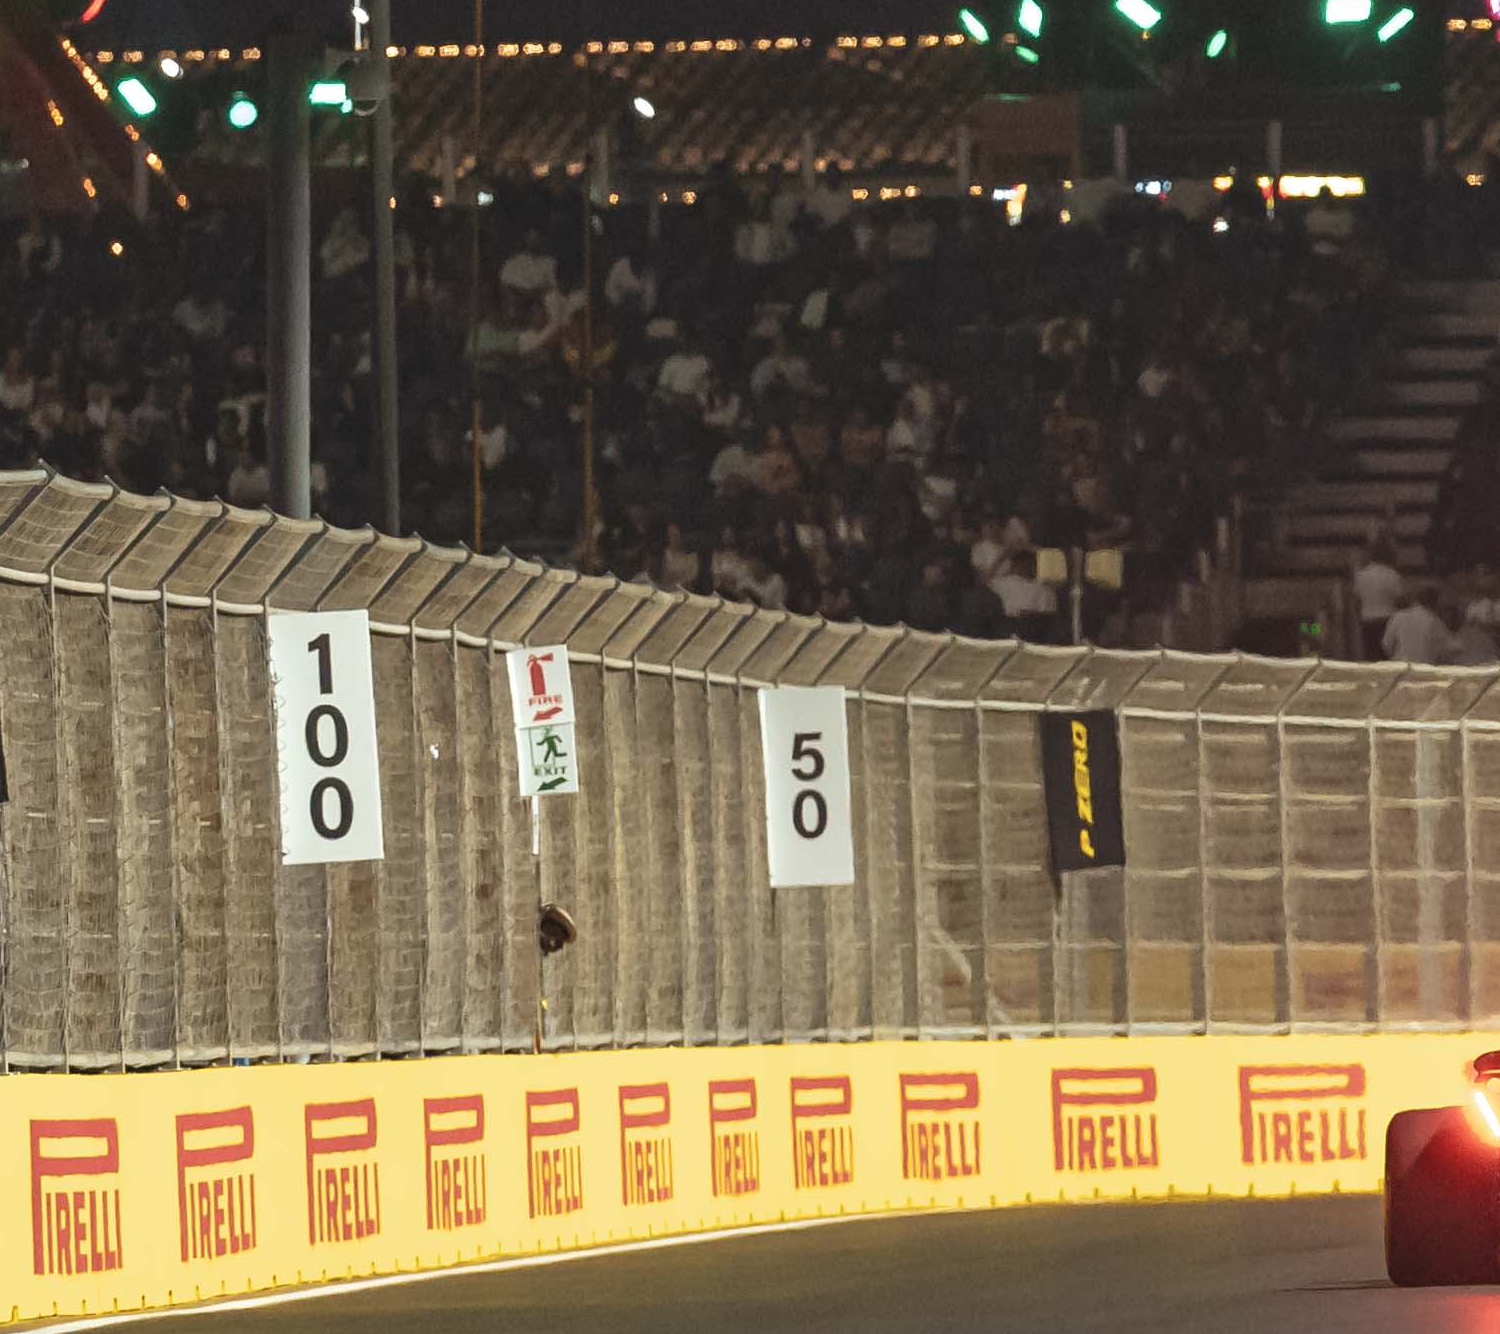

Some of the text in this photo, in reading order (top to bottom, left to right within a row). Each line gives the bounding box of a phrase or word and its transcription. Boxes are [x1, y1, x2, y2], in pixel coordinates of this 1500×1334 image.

[305, 633, 354, 840] 100
[528, 694, 564, 707] FIRE
[534, 766, 567, 776] EXIT
[791, 732, 827, 839] 50
[1071, 720, 1095, 858] P ZERO
[304, 1098, 380, 1245] PIRELLI
[424, 1094, 486, 1229] PIRELLI
[526, 1087, 582, 1218] PIRELLI
[619, 1082, 673, 1206] PIRELLI
[709, 1078, 759, 1197] PIRELLI
[791, 1076, 853, 1189] PIRELLI
[900, 1073, 981, 1179] PIRELLI
[1052, 1067, 1159, 1170] PIRELLI
[1239, 1064, 1367, 1164] PIRELLI
[30, 1119, 123, 1275] PIRELLI
[176, 1106, 256, 1262] PIRELLI
